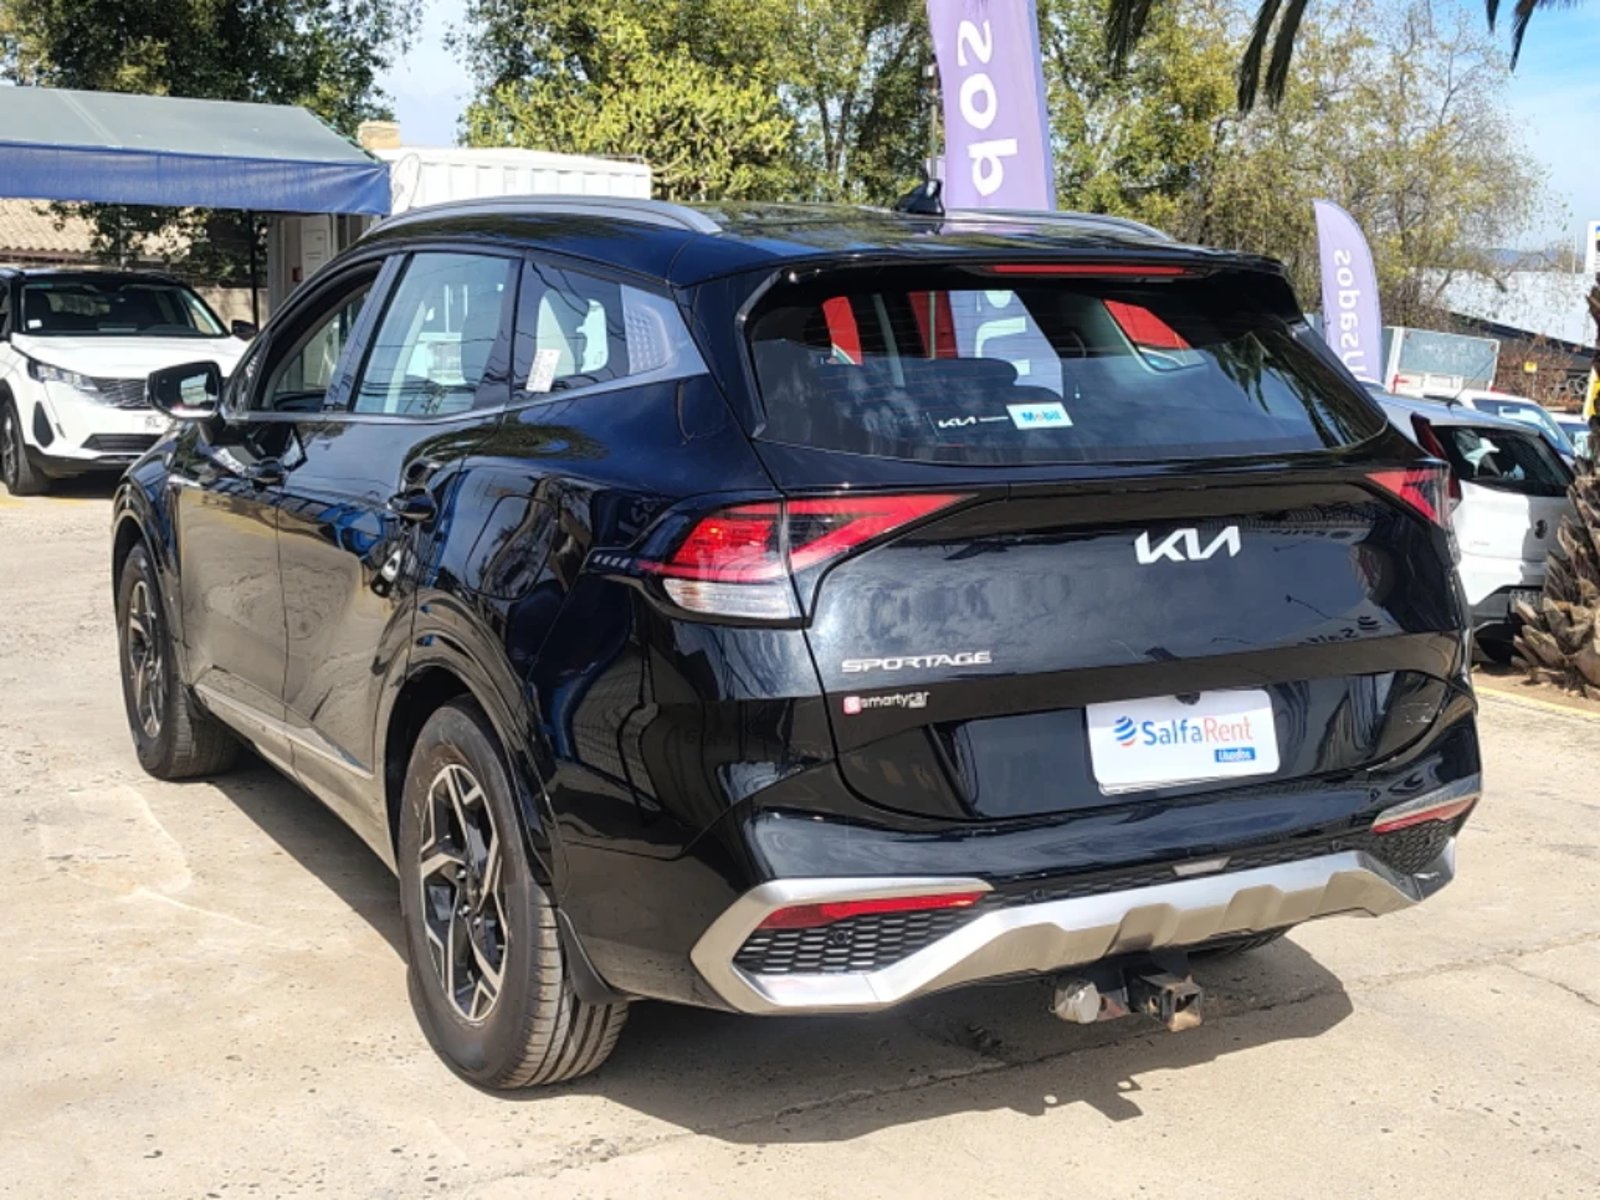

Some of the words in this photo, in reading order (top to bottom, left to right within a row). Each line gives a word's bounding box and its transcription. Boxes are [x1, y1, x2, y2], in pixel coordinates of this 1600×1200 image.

[1134, 525, 1241, 565] KIA
[841, 650, 993, 673] SPORTAGE
[1141, 715, 1254, 746] SalfaRent
